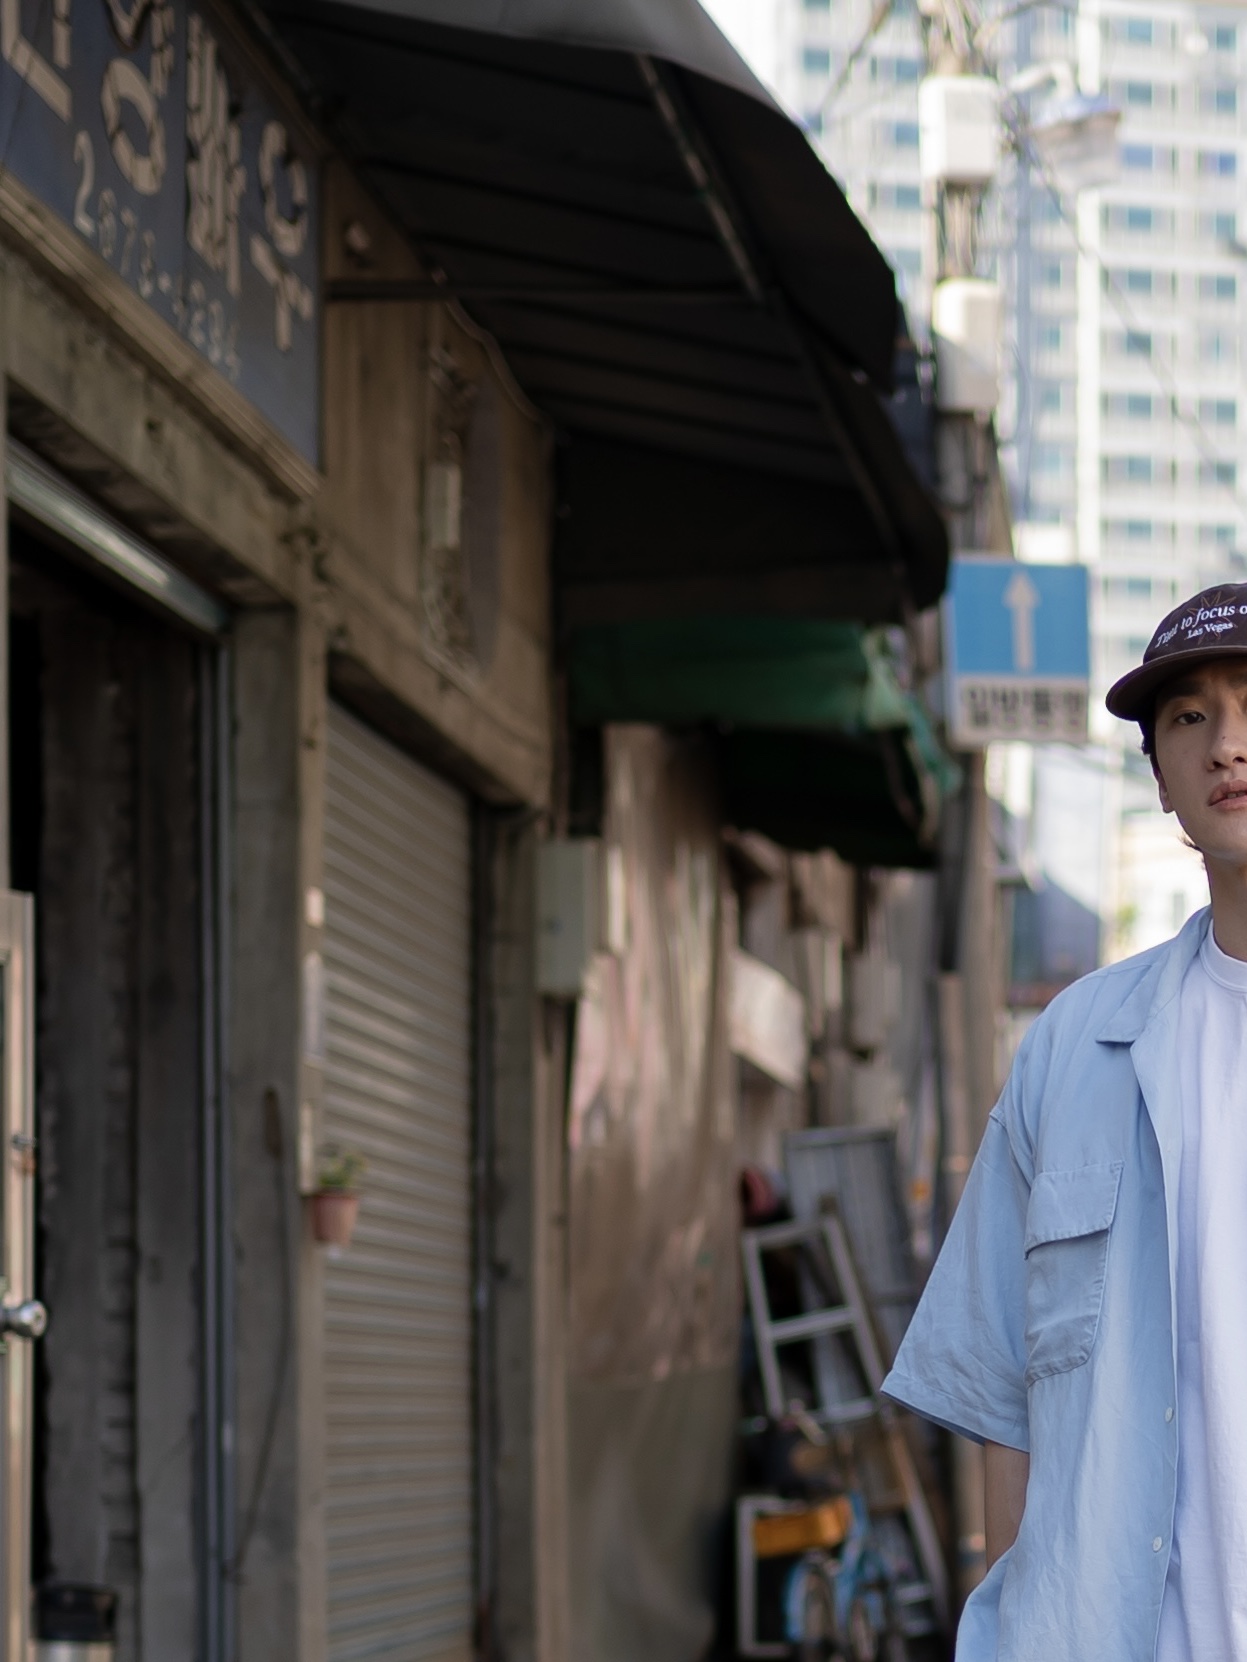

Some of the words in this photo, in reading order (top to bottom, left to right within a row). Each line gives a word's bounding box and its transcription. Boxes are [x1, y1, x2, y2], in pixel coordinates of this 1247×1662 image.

[1181, 616, 1193, 630] to
[1192, 606, 1236, 629] focus
[1187, 627, 1204, 639] Las
[1204, 622, 1234, 633] Vegas
